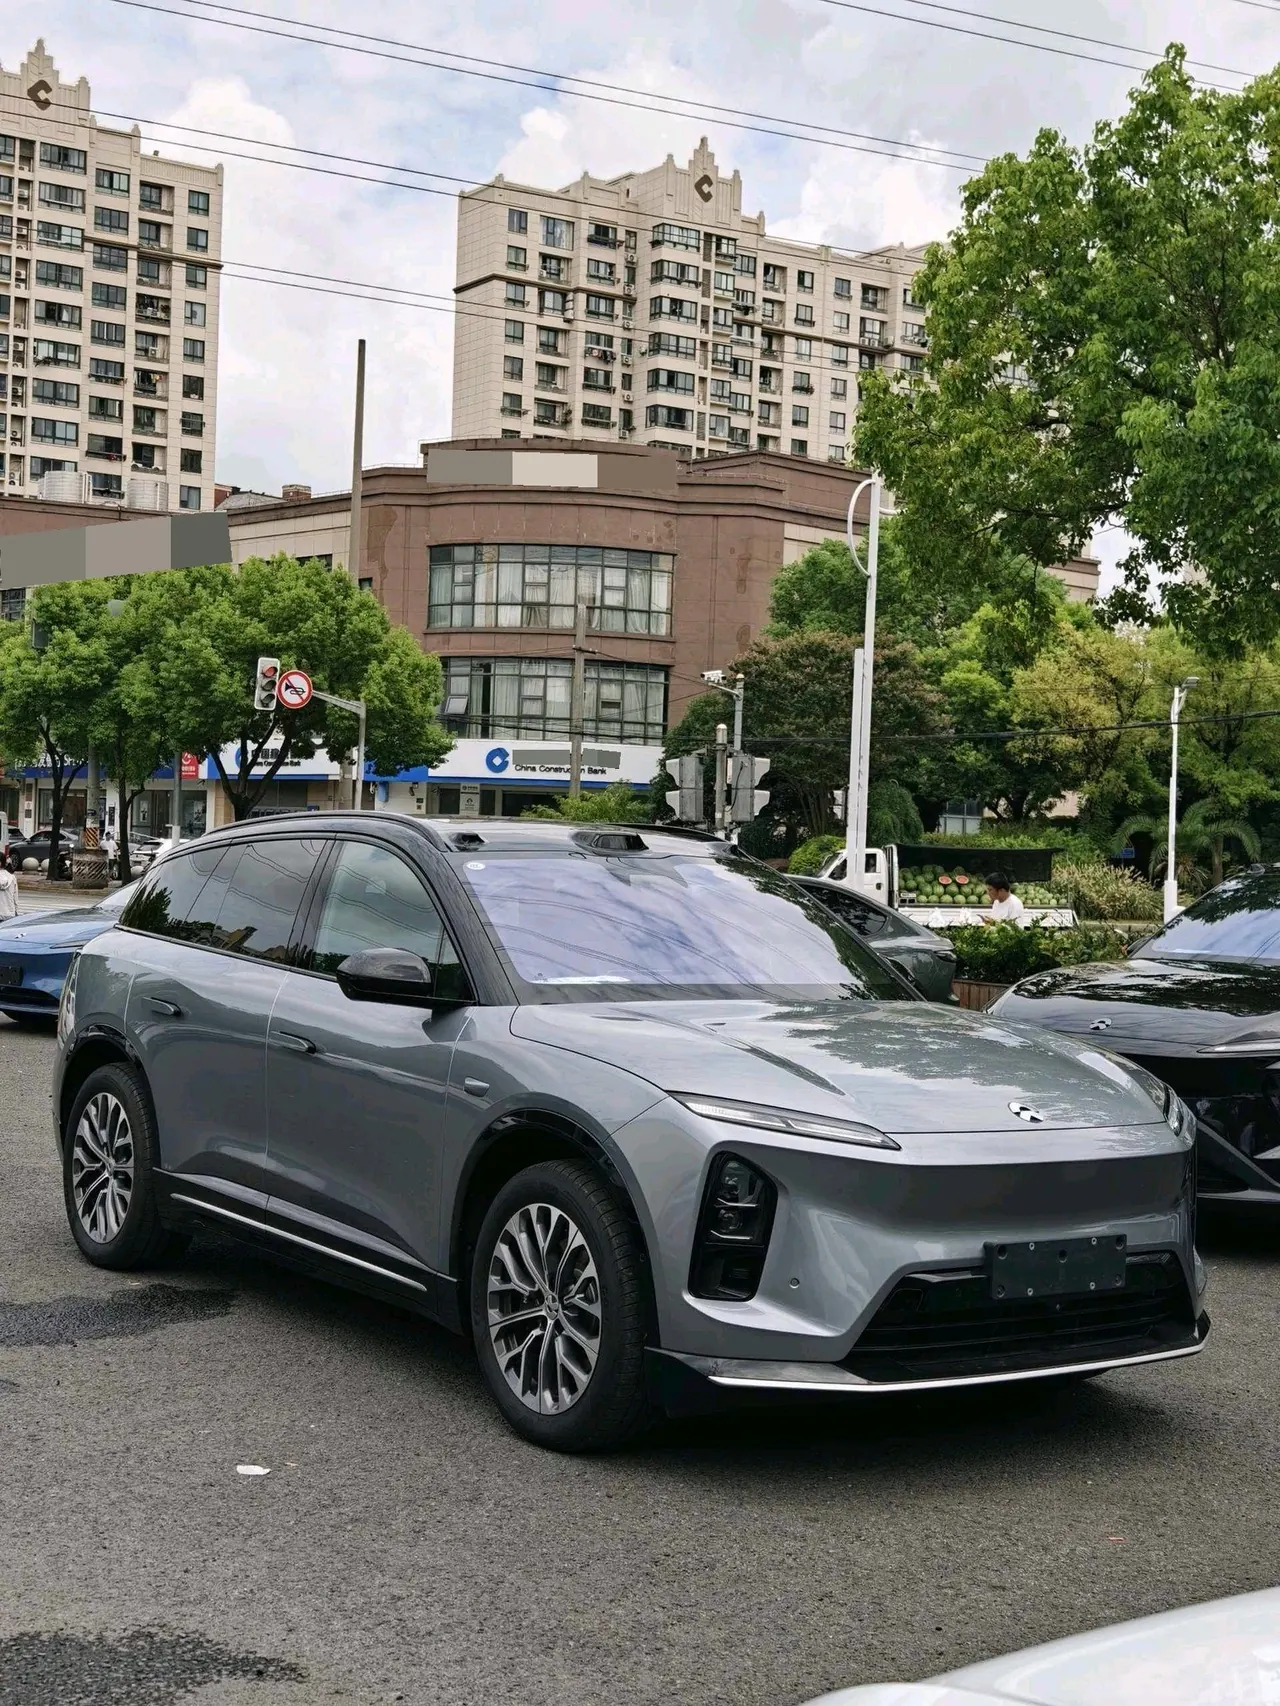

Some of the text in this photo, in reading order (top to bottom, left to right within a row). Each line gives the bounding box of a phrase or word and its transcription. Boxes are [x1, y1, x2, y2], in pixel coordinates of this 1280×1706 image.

[514, 764, 607, 775] China Construcn Bank
